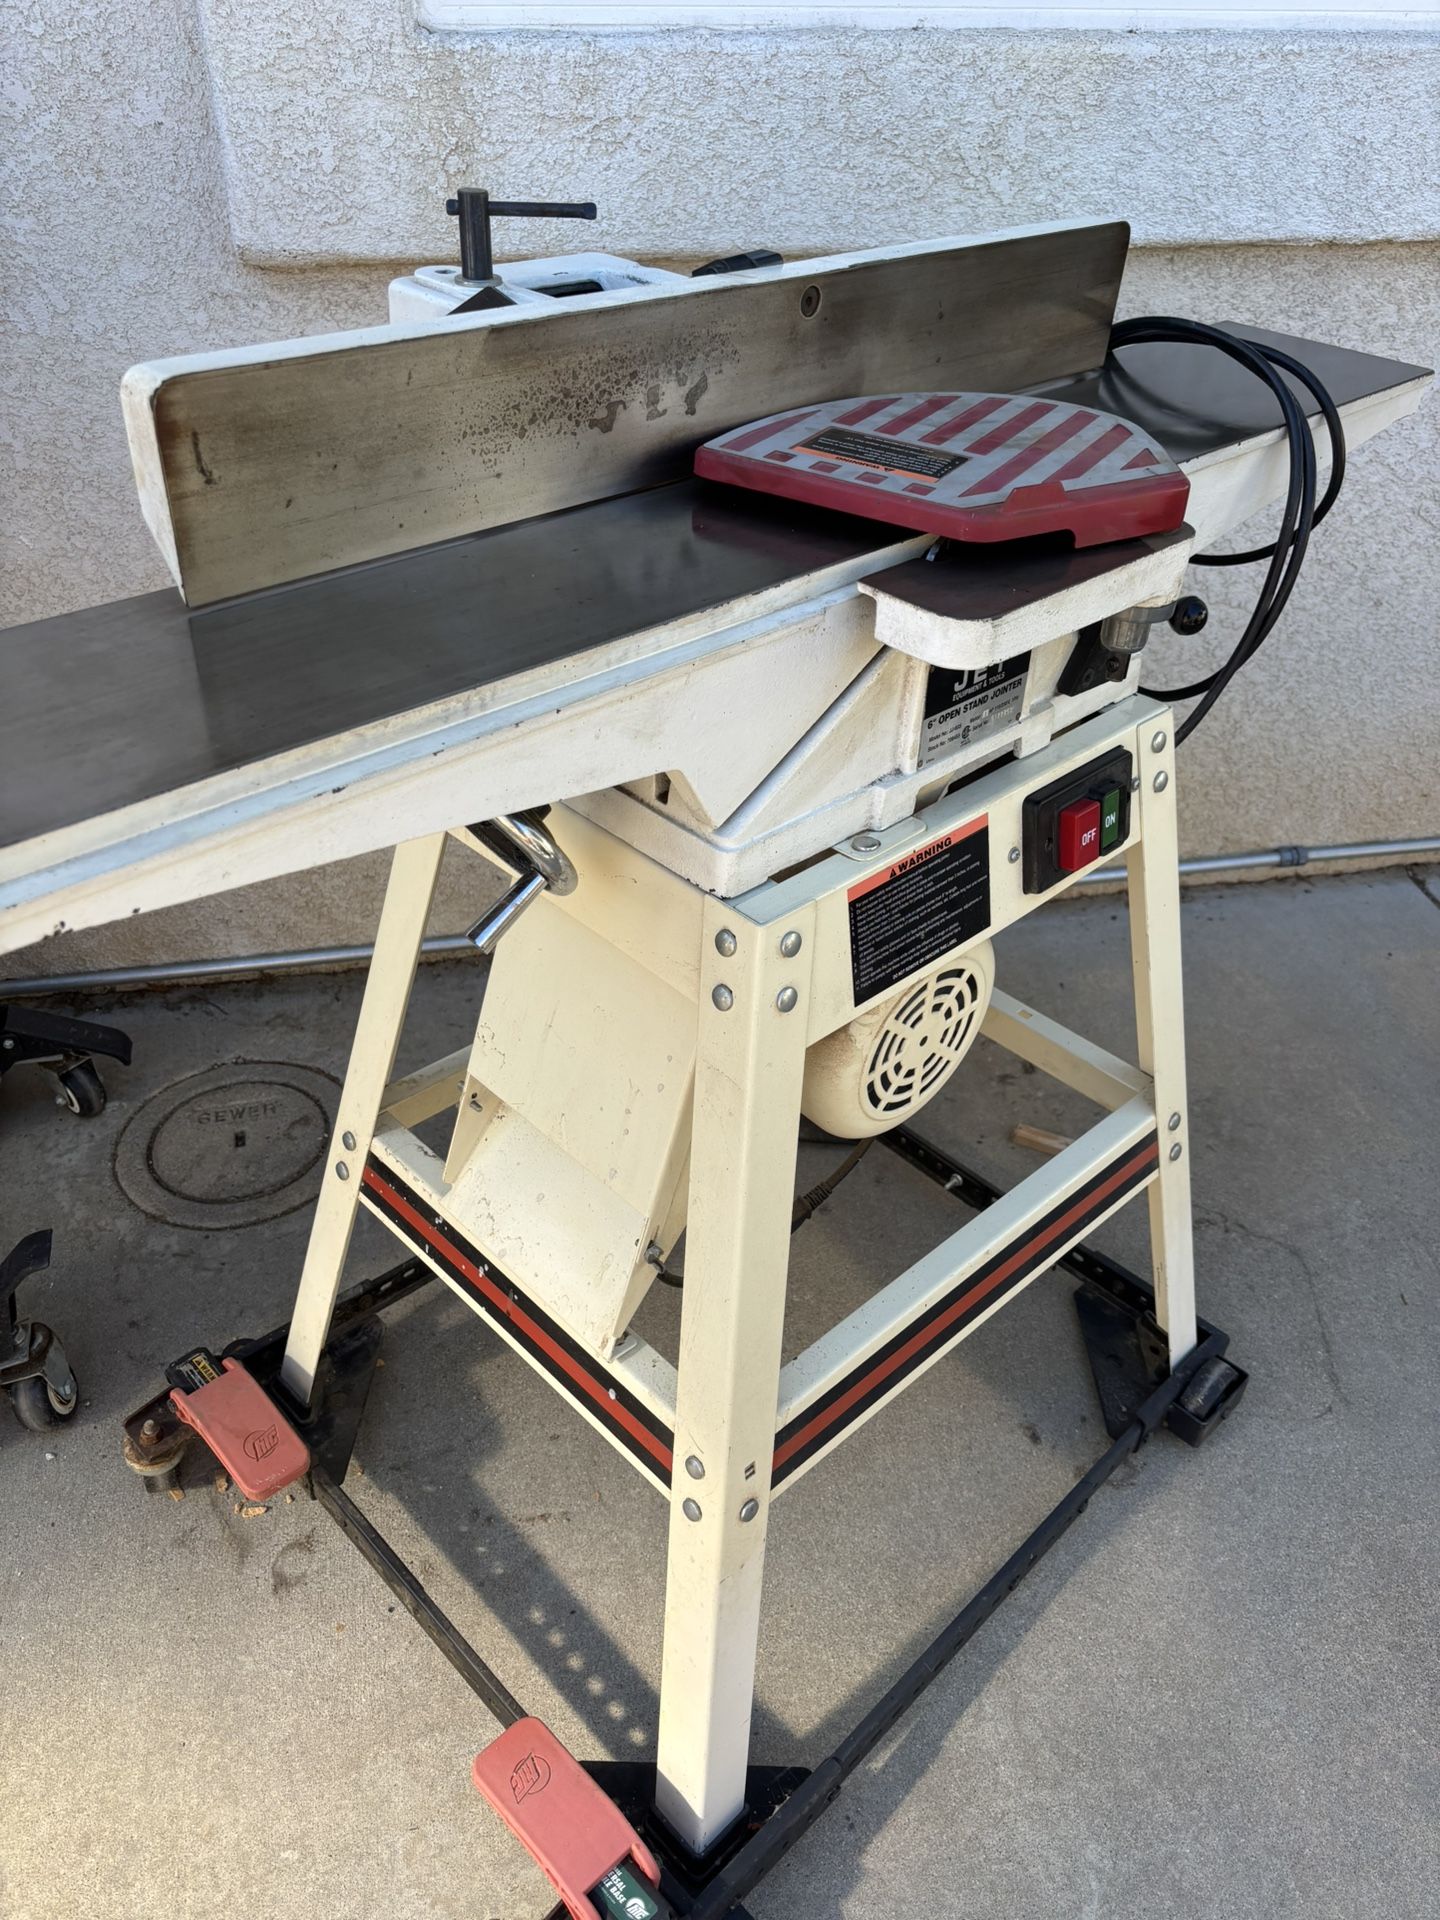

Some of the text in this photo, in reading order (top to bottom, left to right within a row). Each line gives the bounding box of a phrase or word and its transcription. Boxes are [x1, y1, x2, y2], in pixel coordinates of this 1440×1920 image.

[952, 683, 982, 702] EQUIPMENT
[988, 671, 1006, 685] TOOLS
[938, 706, 962, 725] OPEN
[962, 694, 989, 714] STAND
[990, 677, 1023, 700] JOINTER
[1105, 811, 1116, 828] ON
[1081, 827, 1097, 846] OFF
[897, 837, 952, 873] WARNING
[198, 1102, 278, 1125] SEWER
[200, 1363, 218, 1382] WARN
[607, 1869, 627, 1892] ERSAL
[609, 1886, 627, 1904] BASE
